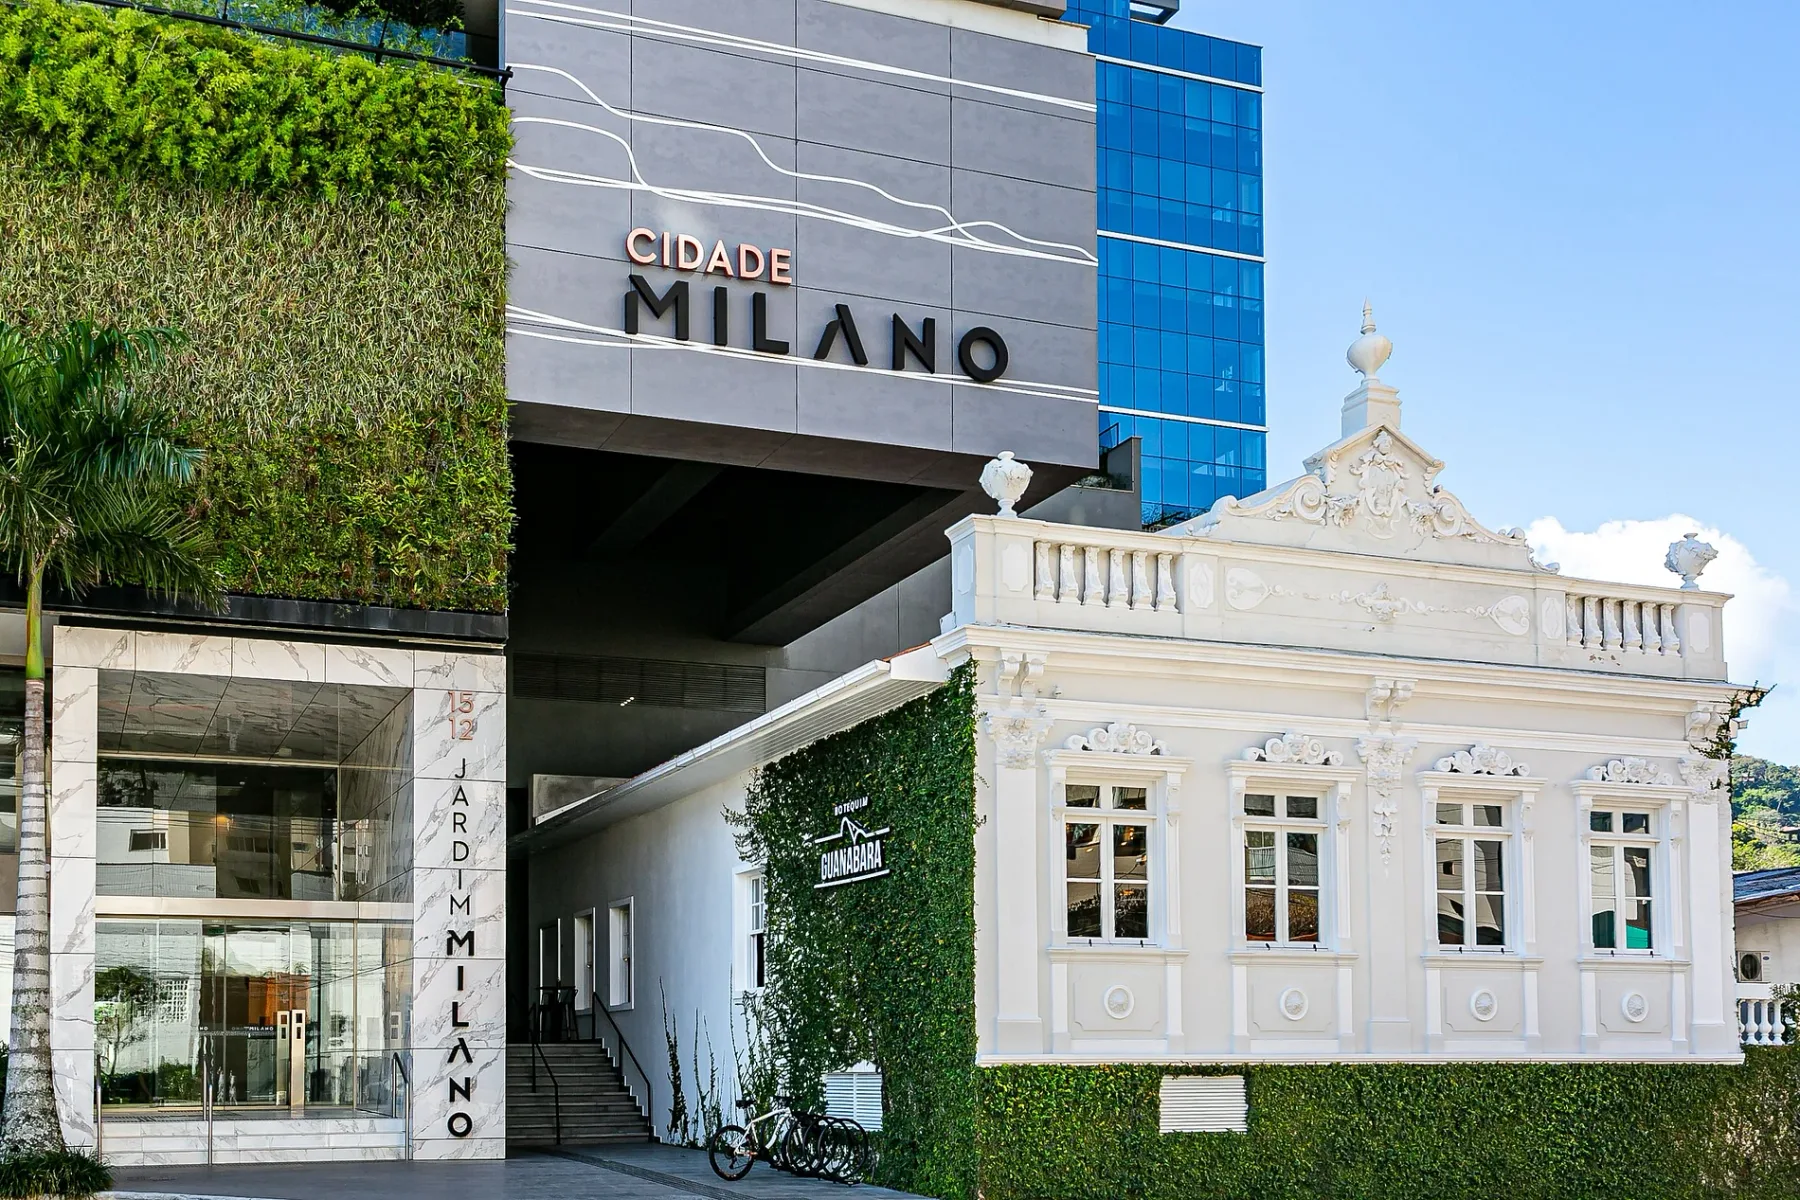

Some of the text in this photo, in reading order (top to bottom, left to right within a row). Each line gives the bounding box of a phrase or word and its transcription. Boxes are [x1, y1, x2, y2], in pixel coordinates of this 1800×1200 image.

[625, 227, 792, 286] CIDADE
[624, 273, 1010, 383] MILANO
[448, 691, 475, 714] 15
[448, 717, 474, 741] 12
[834, 796, 869, 816] BOTEQUIM
[821, 839, 882, 880] GUANABARA
[446, 757, 475, 1138] JARDIM MILANO
